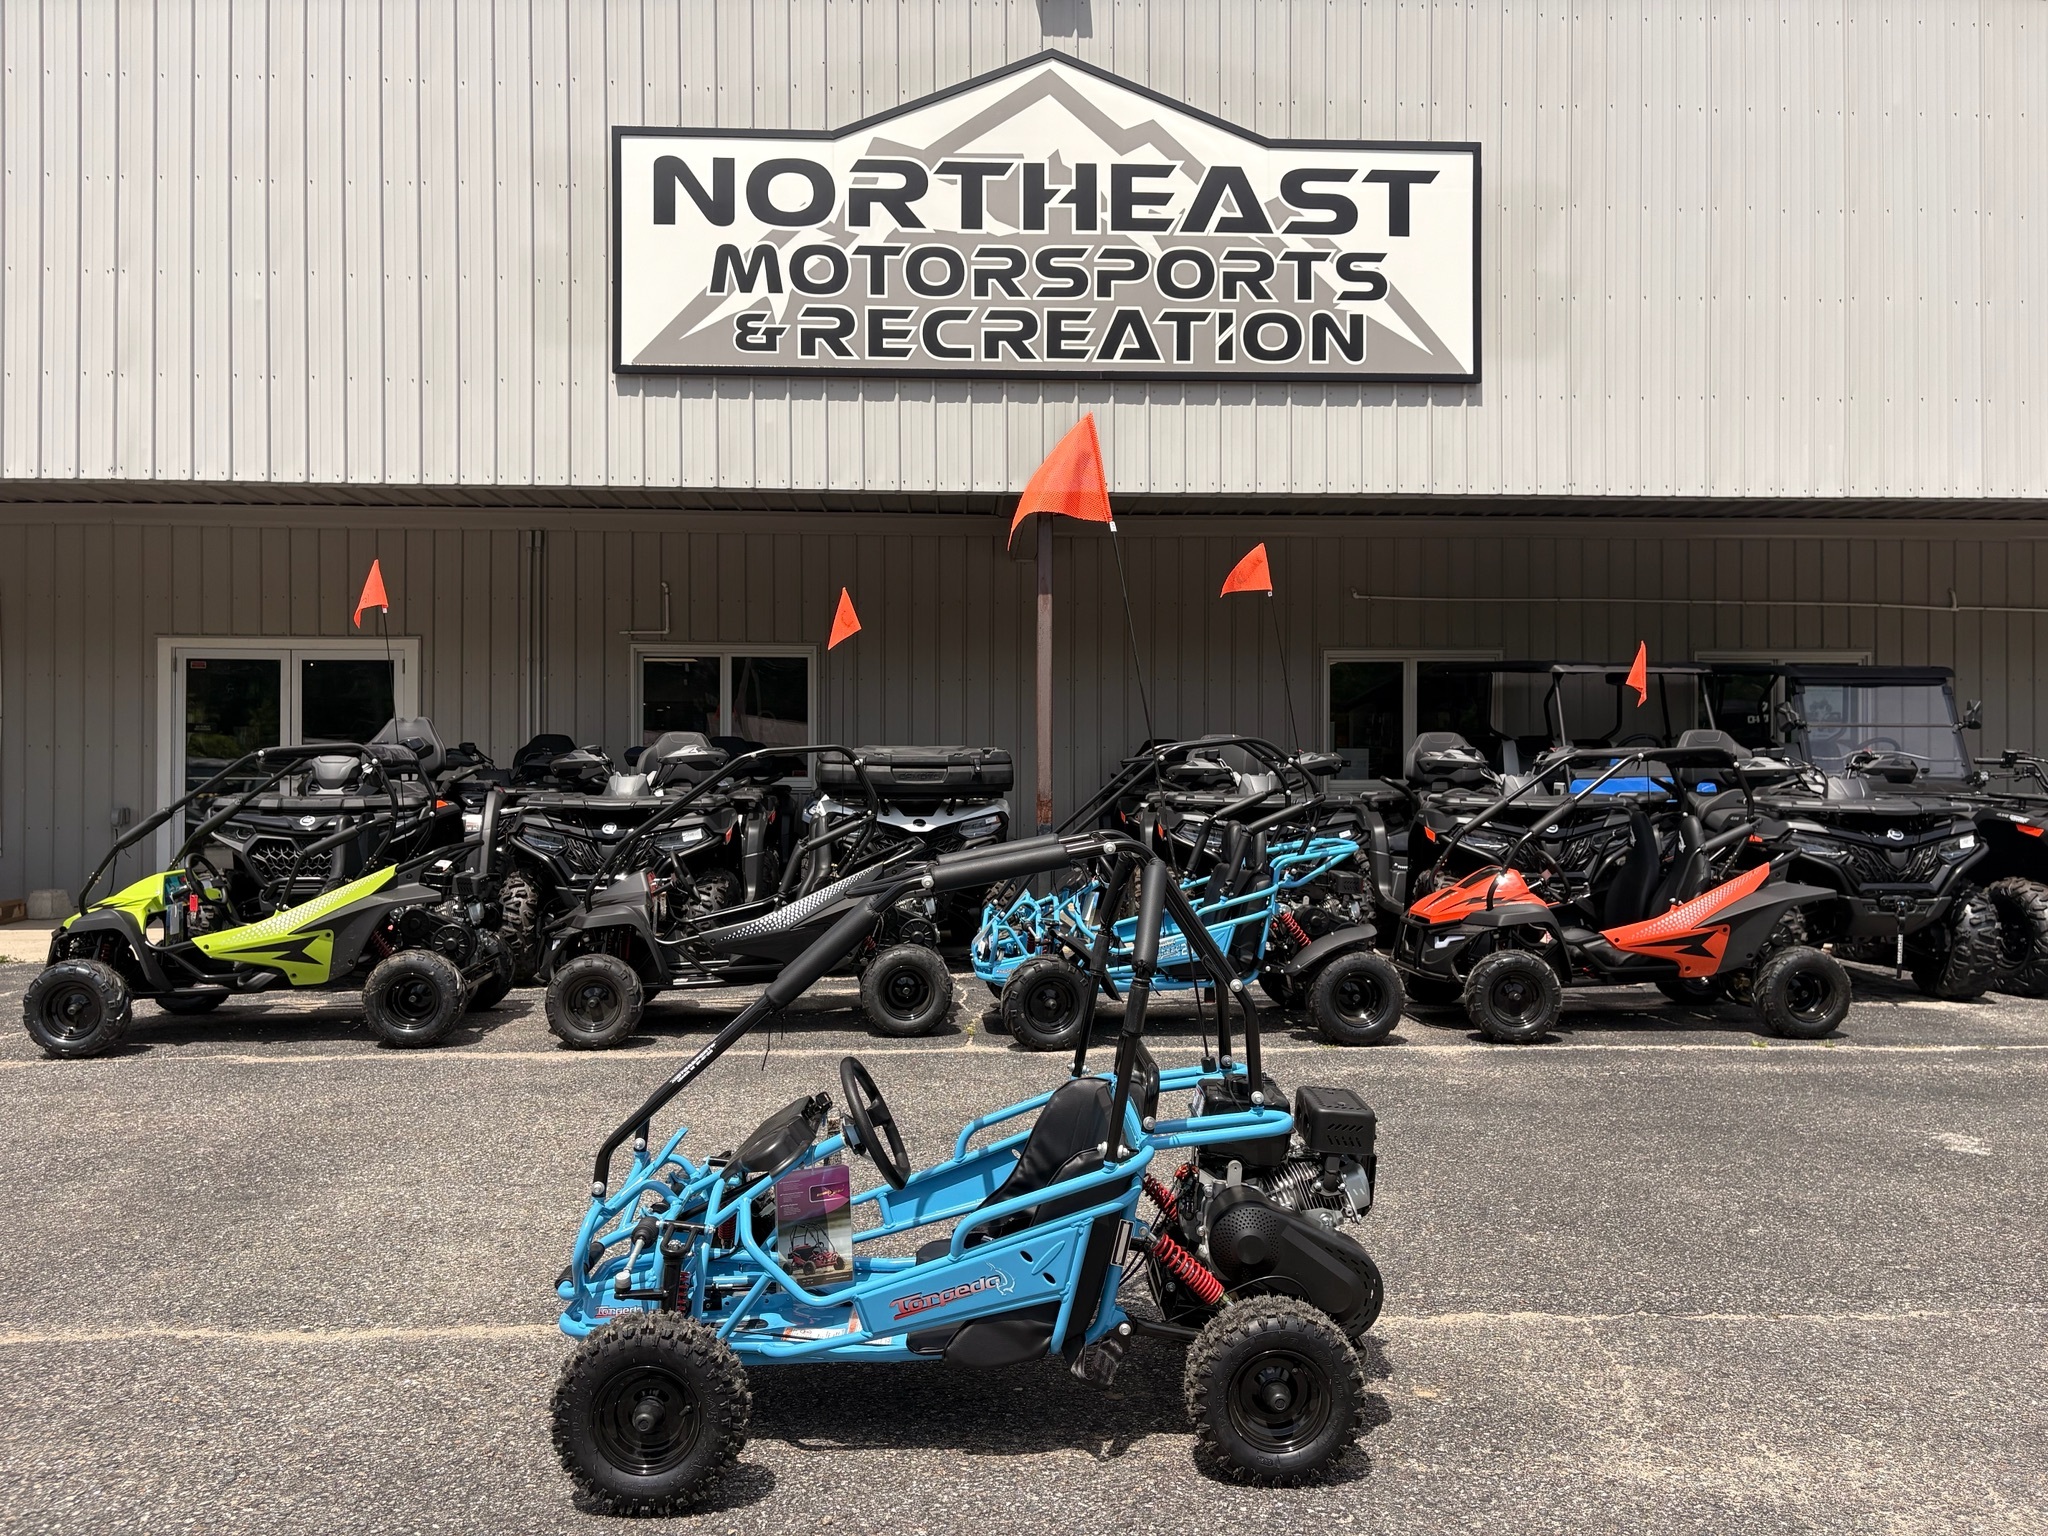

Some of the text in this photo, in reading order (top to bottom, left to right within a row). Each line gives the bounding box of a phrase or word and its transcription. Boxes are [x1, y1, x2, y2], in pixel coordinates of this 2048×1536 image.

[653, 155, 1440, 237] NORTHEAST
[709, 243, 1388, 301] MOTORSPORTS
[889, 1275, 1001, 1320] Torpedo
